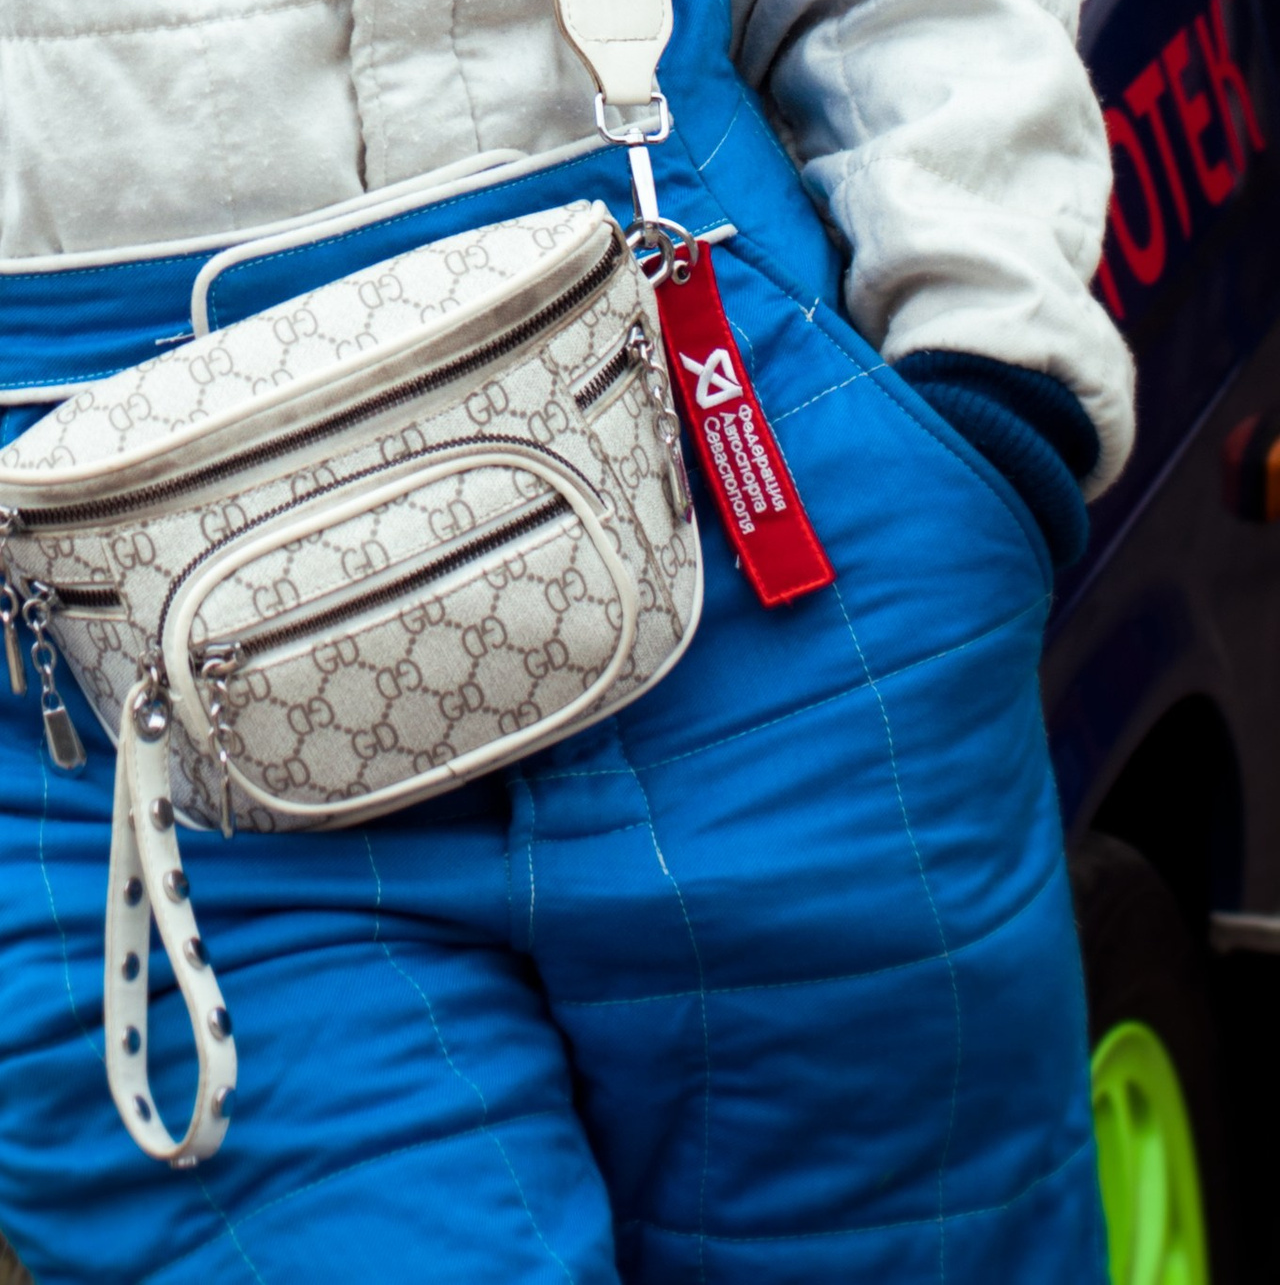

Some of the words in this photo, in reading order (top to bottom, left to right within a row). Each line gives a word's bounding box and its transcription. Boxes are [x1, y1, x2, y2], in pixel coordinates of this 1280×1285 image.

[703, 415, 756, 535] Севастополя
[719, 411, 768, 514] Автоспорта
[737, 403, 787, 513] Федерация
